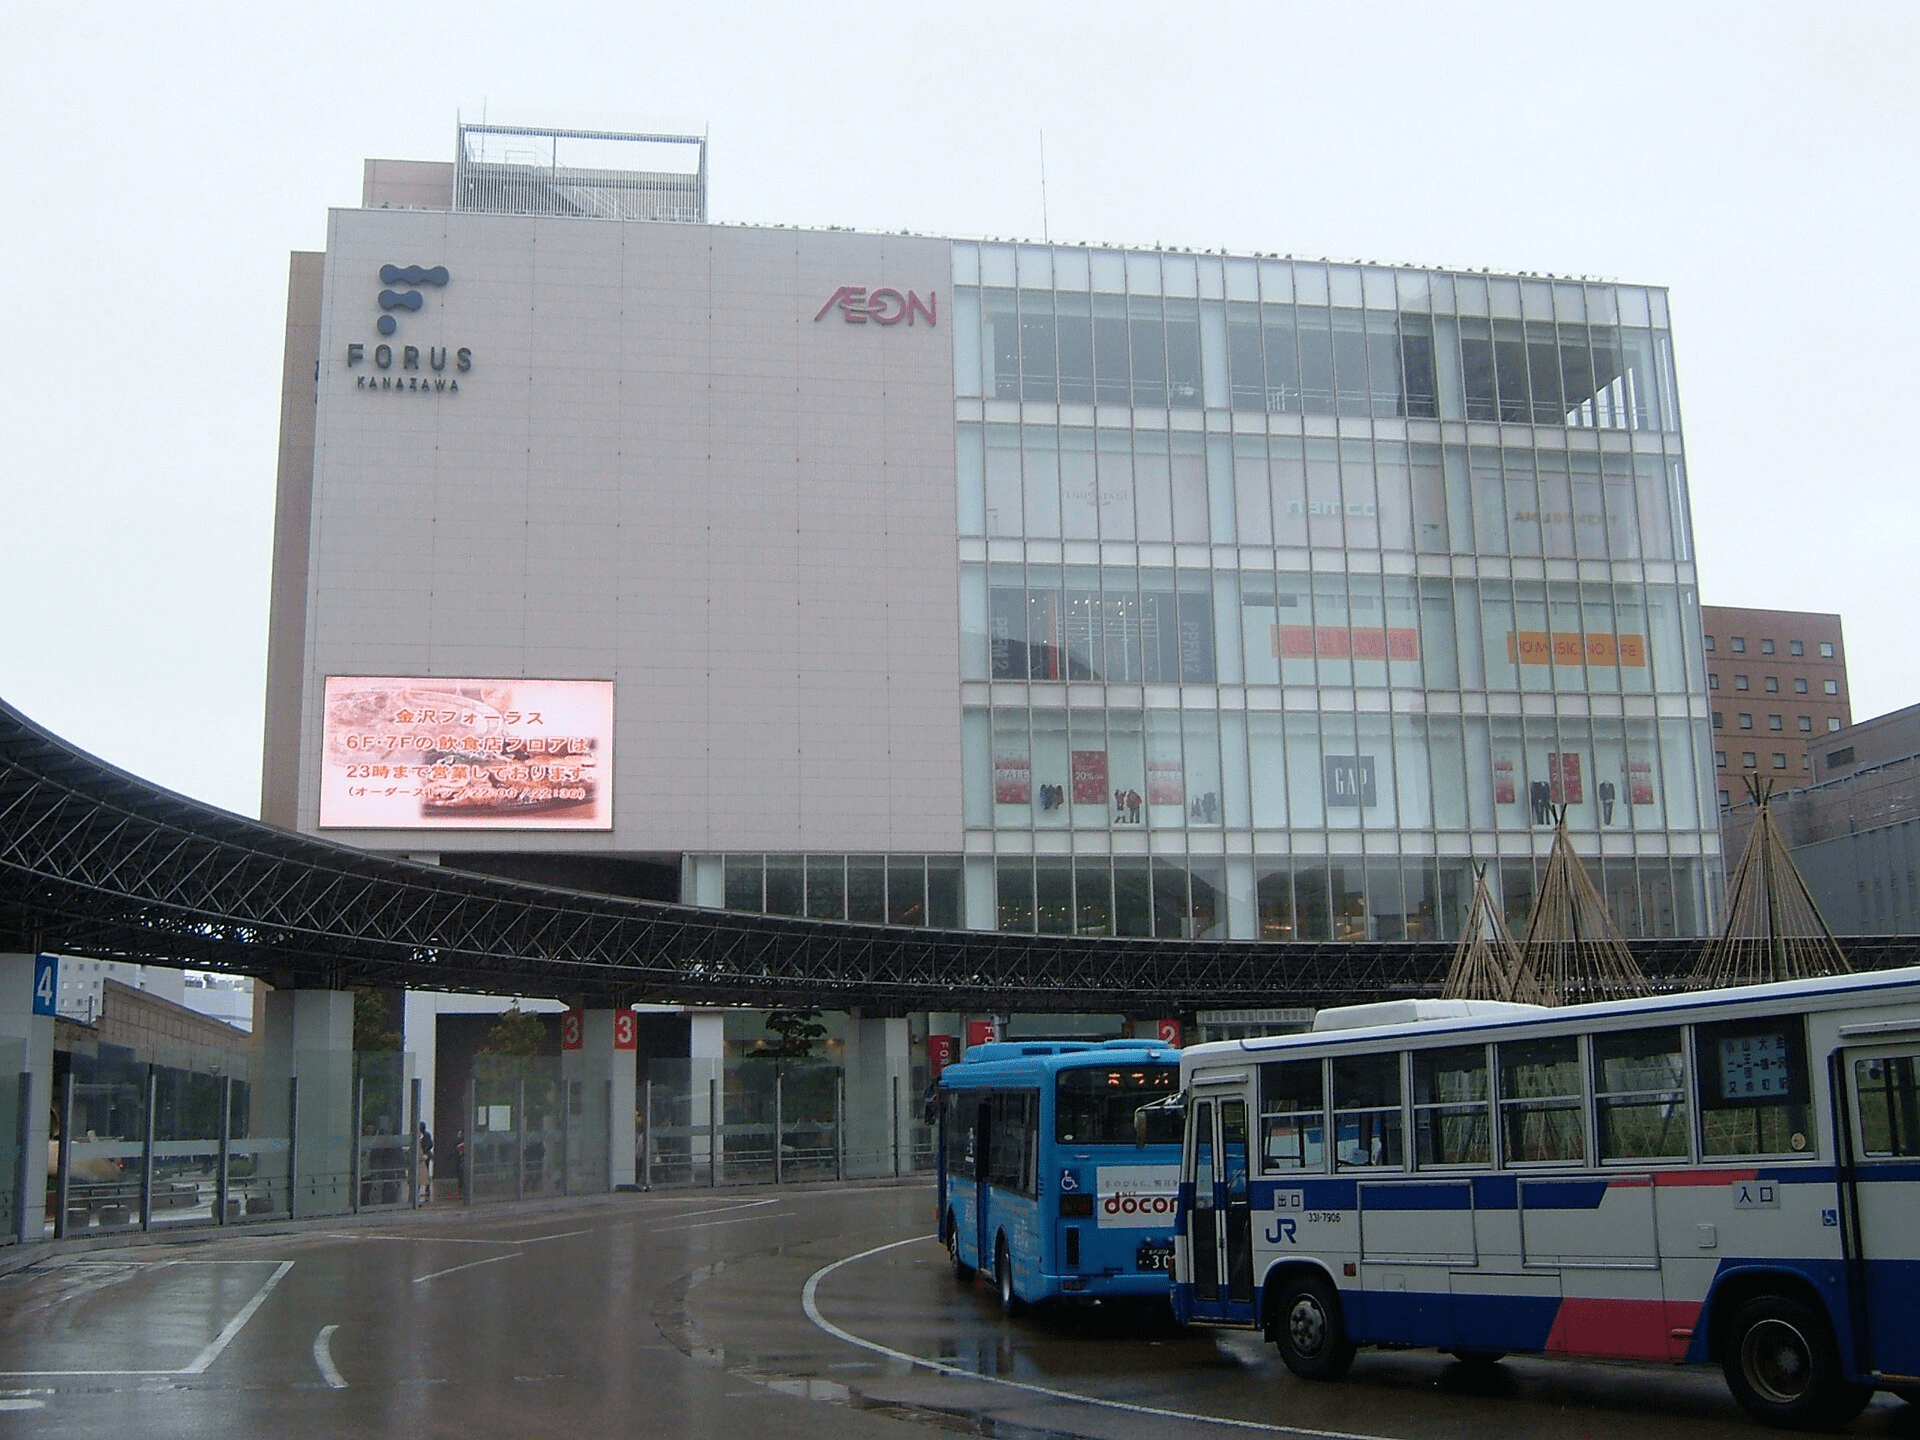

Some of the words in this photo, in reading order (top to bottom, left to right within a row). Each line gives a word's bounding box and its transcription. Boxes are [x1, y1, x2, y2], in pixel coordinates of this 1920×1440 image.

[348, 343, 473, 373] FORUS
[357, 376, 459, 393] KANAZAWA
[1286, 500, 1376, 516] namco
[396, 709, 544, 725] 金沢フォーラス
[998, 770, 1029, 780] SALE
[1334, 766, 1368, 795] GAP
[37, 966, 53, 1006] 4
[566, 1015, 580, 1043] 3
[618, 1015, 632, 1044] 3
[1161, 1026, 1176, 1047] 2
[1278, 1195, 1300, 1207] 出口
[1739, 1186, 1773, 1203] 入口
[1265, 1218, 1296, 1243] JR
